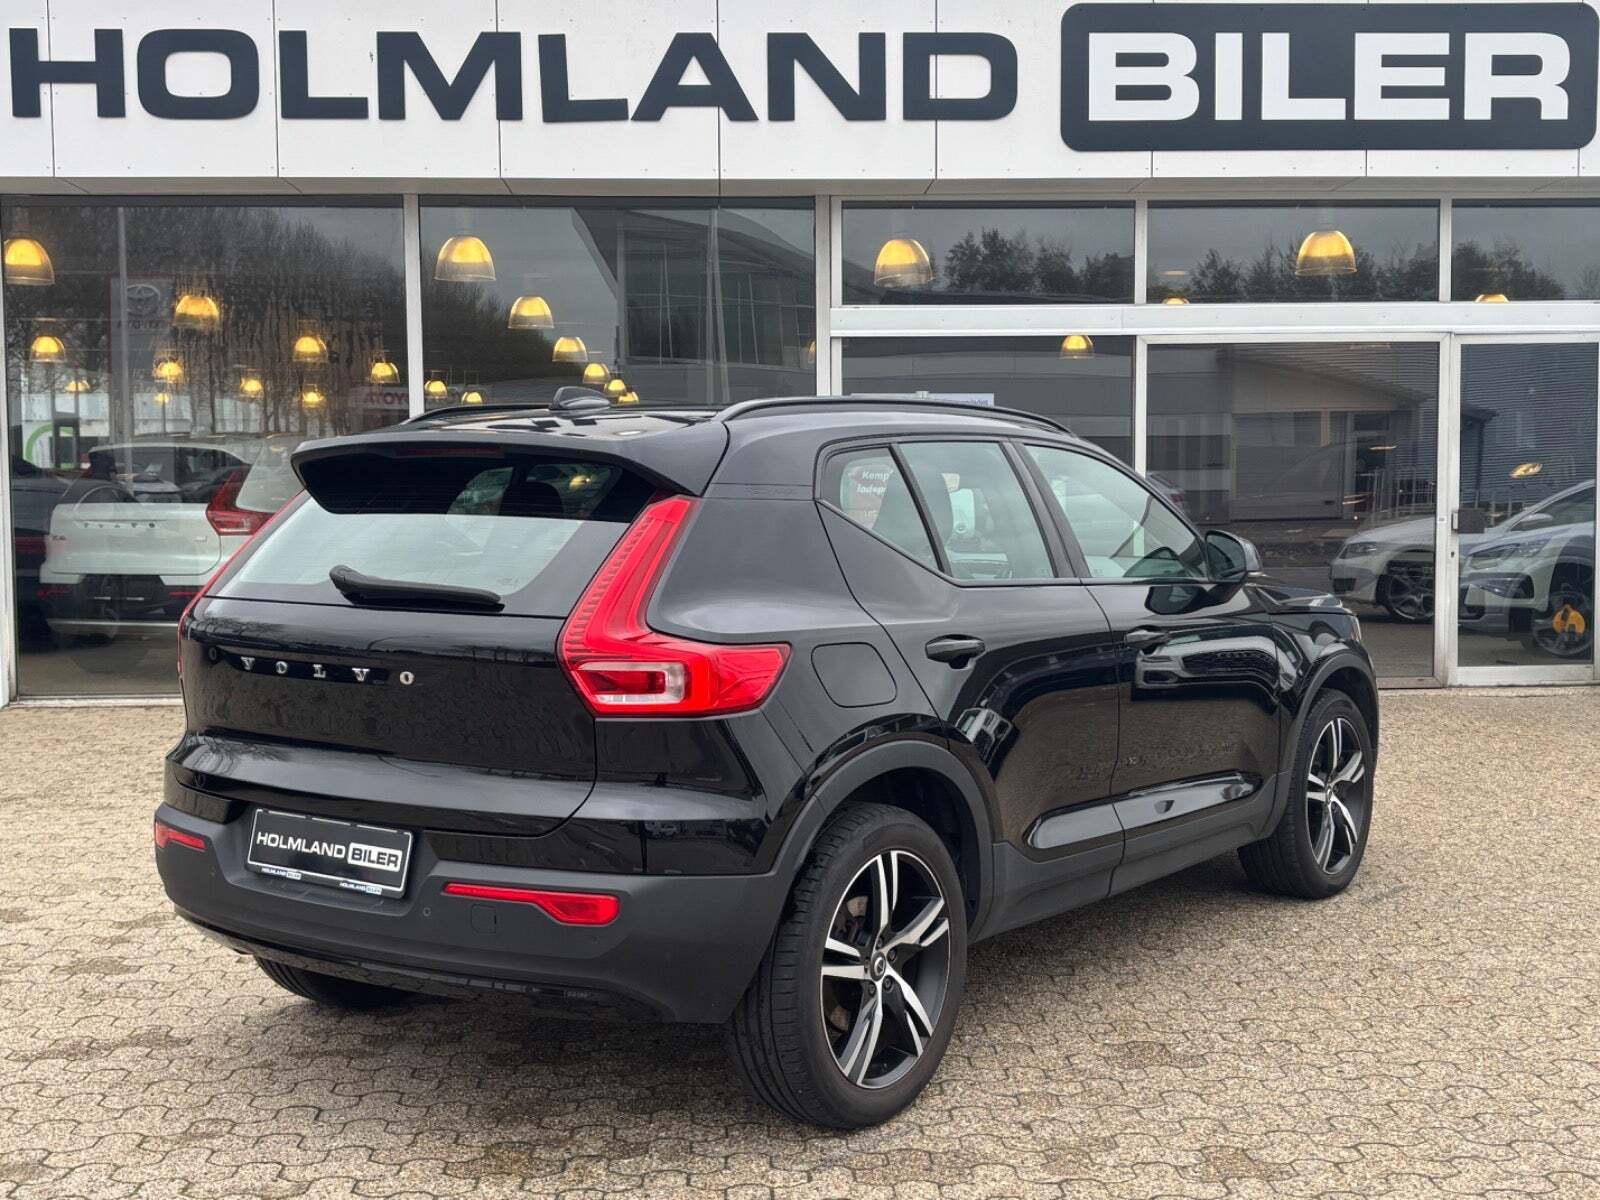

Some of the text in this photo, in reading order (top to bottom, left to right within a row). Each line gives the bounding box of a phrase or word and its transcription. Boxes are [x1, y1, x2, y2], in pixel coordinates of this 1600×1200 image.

[9, 28, 1571, 122] HOLMLAND BILER
[240, 656, 415, 686] VOLVO
[256, 831, 399, 868] HOLMLAND BILER
